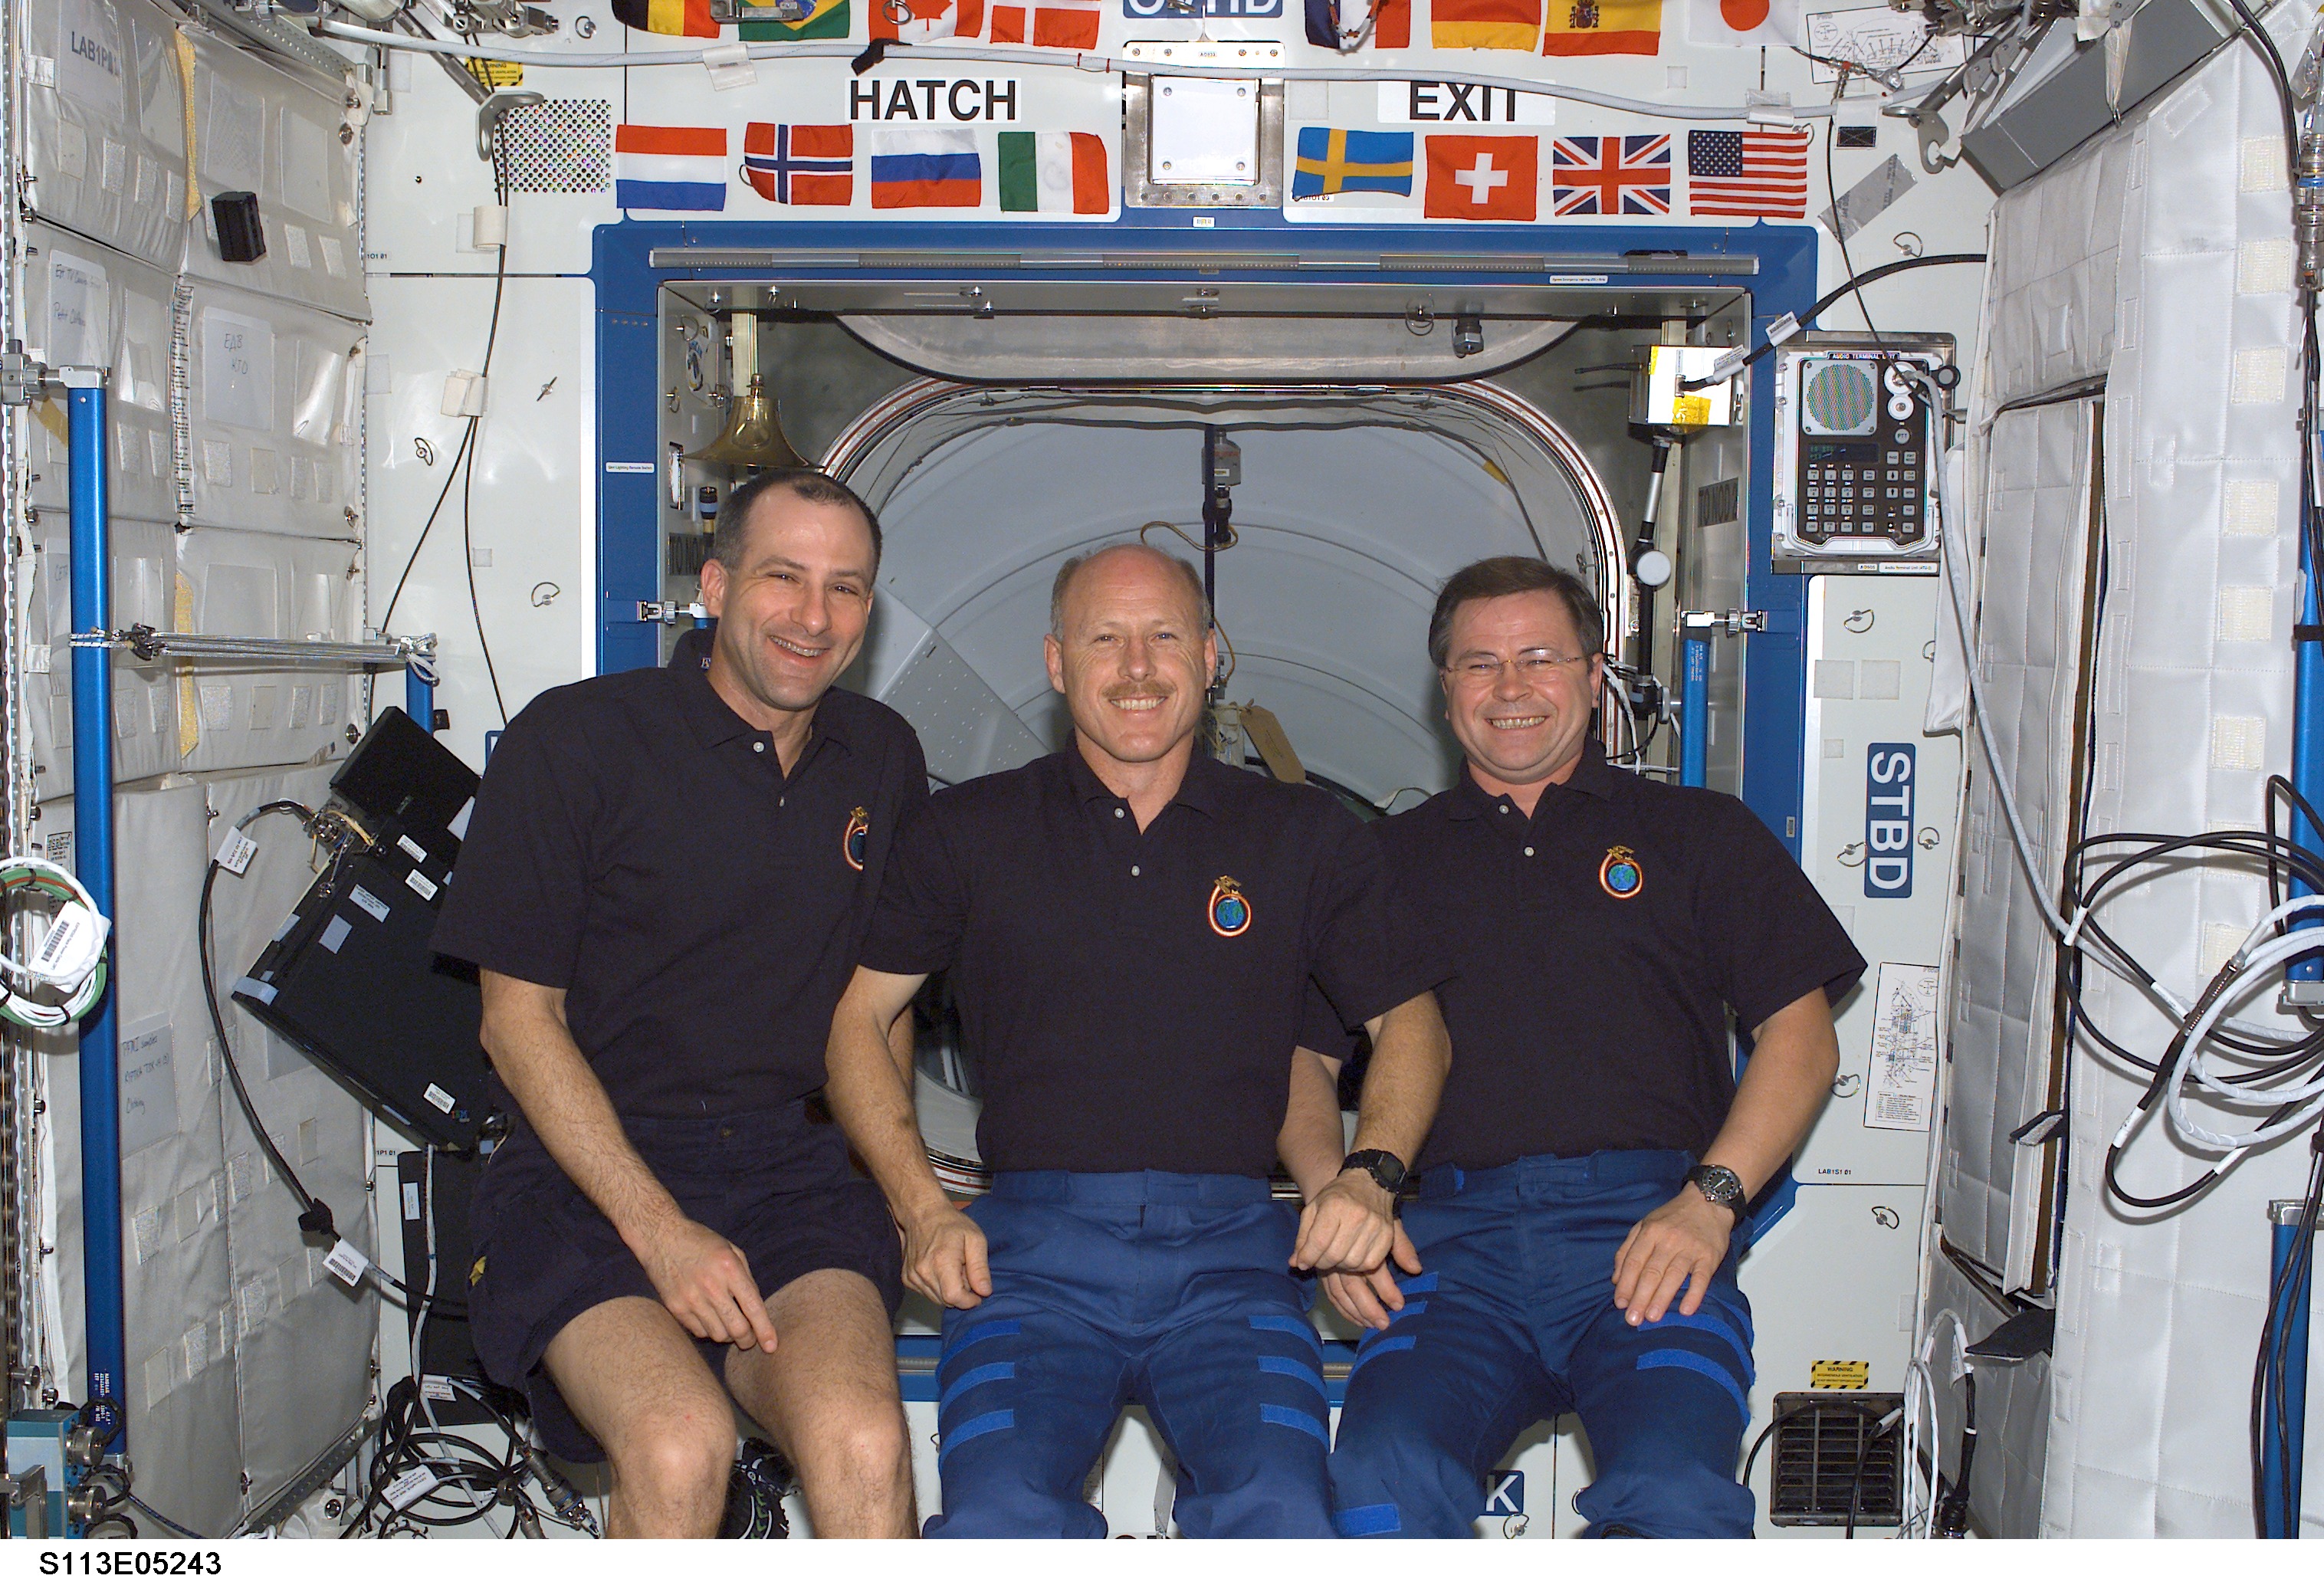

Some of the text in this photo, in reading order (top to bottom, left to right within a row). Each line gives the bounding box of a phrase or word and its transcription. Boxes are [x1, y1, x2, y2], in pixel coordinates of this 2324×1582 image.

[851, 80, 1515, 121] HATCH EXIT
[1869, 751, 1910, 890] STBD
